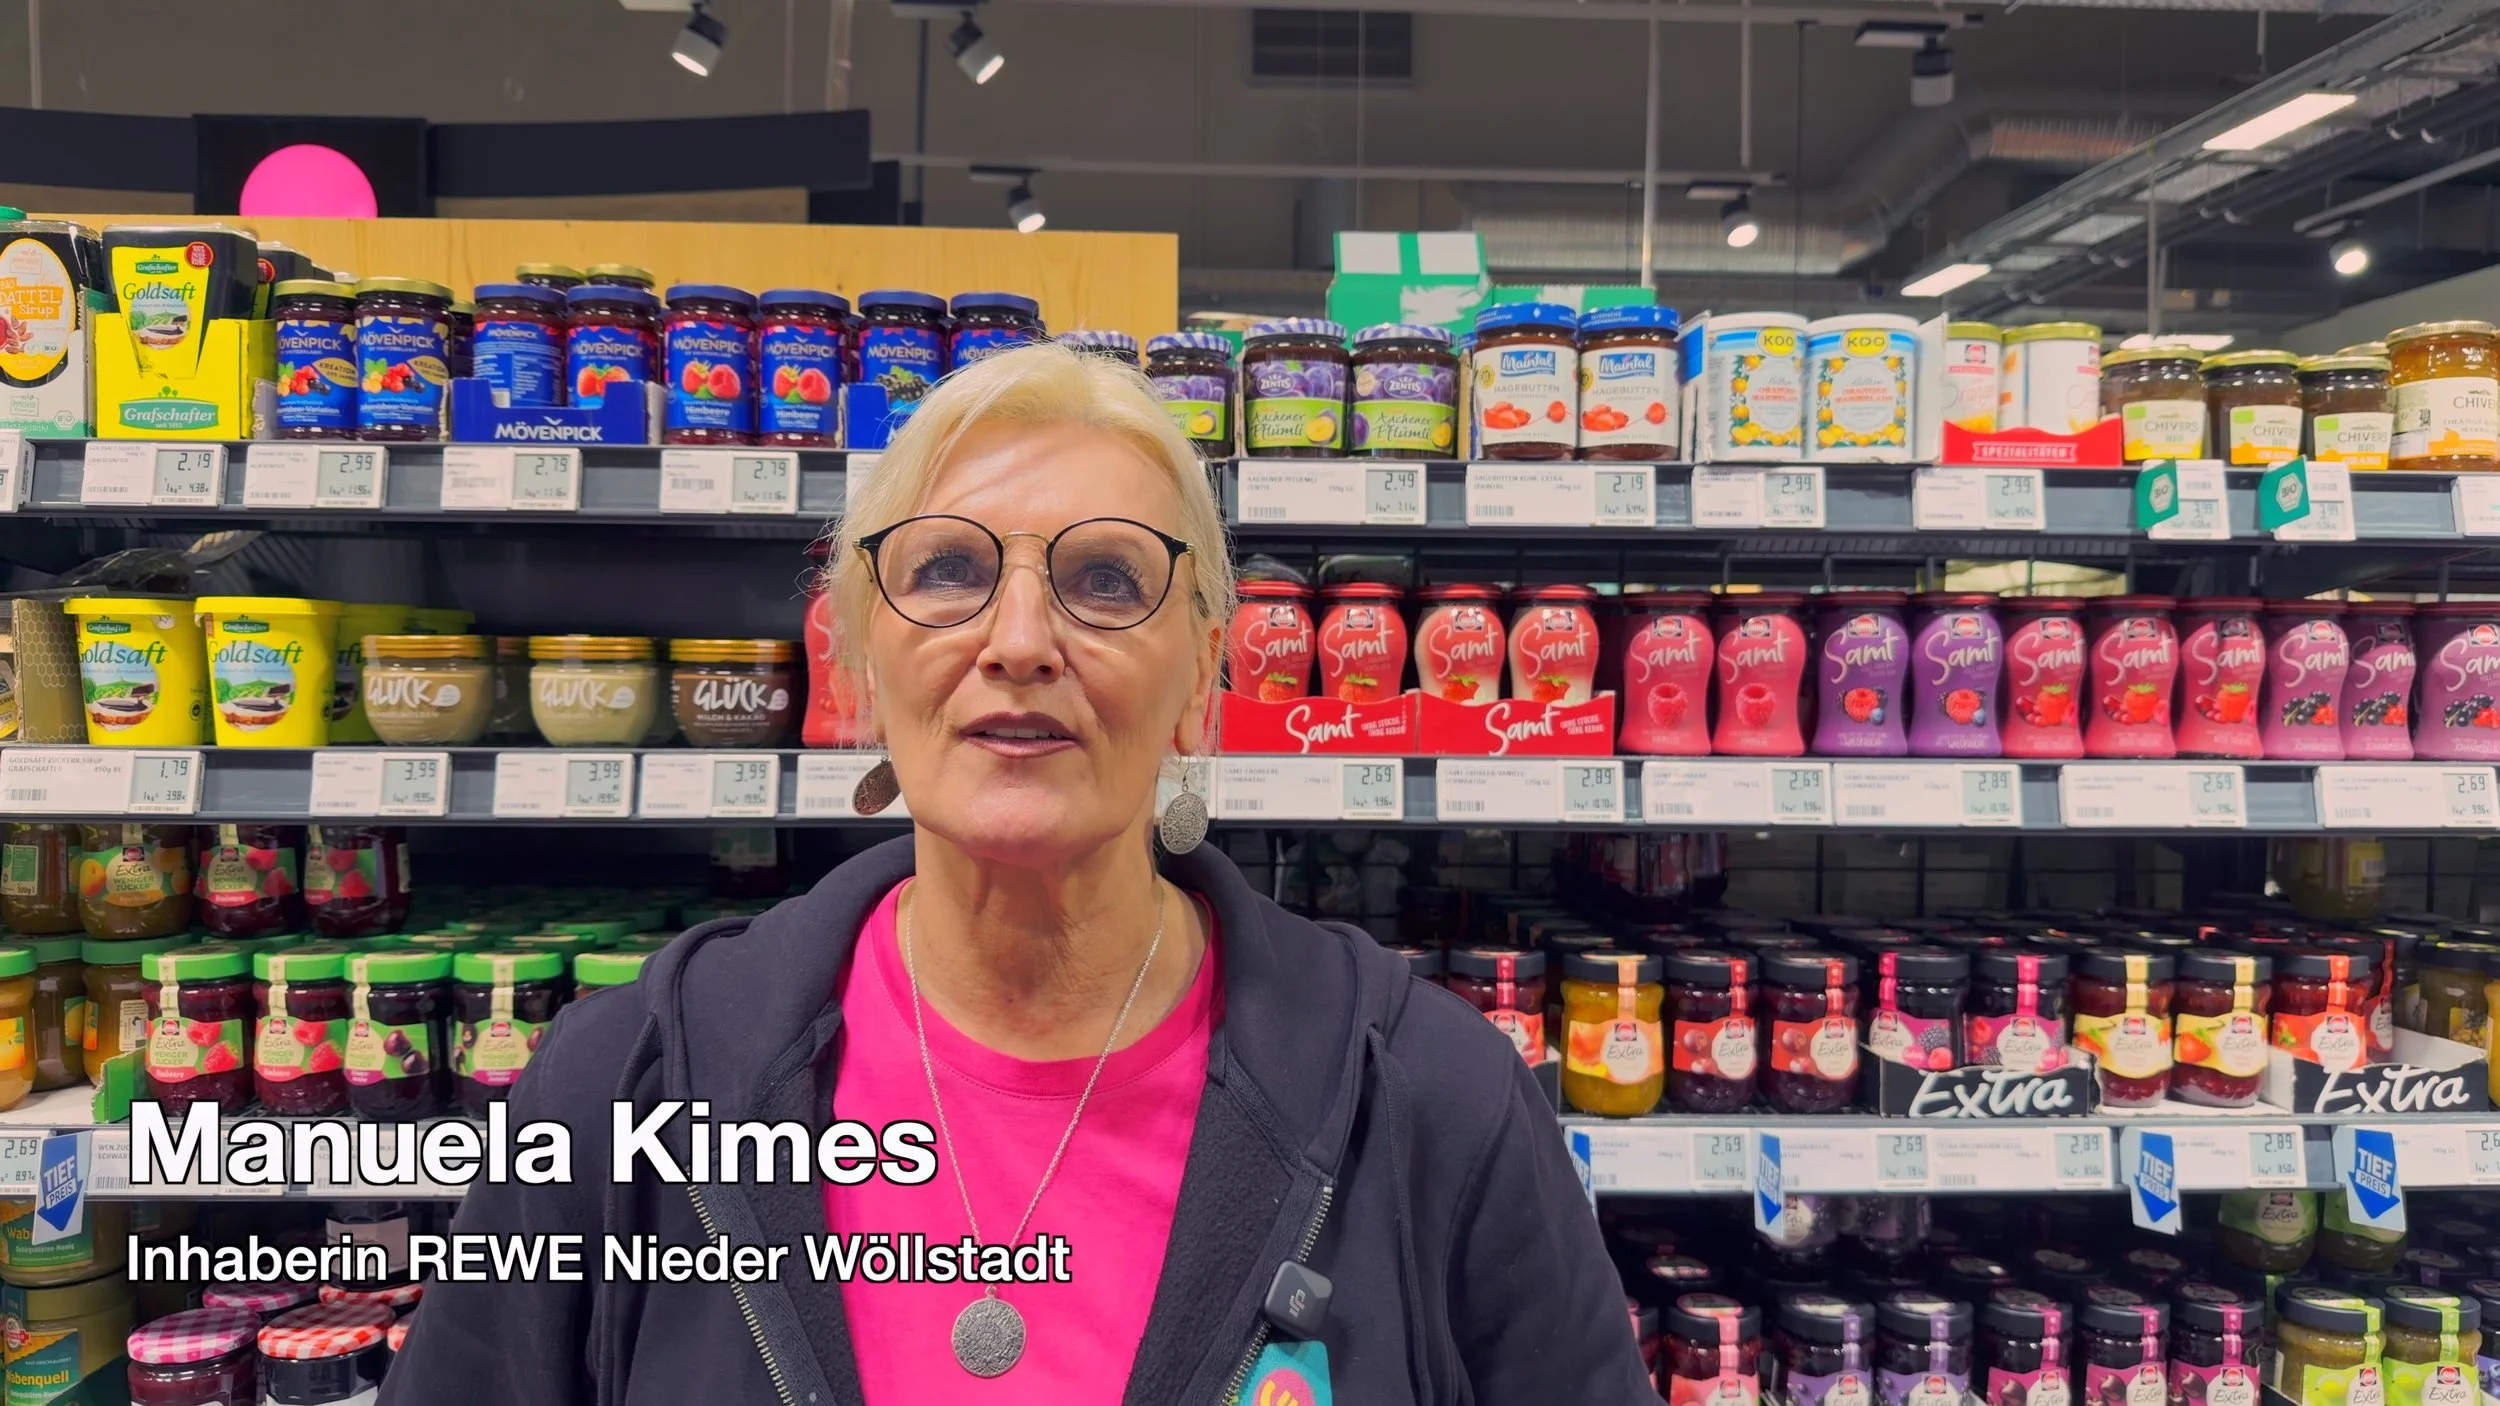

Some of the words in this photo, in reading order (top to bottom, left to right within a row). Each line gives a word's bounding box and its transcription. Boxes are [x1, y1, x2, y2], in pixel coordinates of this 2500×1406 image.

[123, 282, 197, 302] Goldsaft
[19, 305, 54, 321] Sirup
[360, 331, 435, 349] MÖVENPICK
[487, 325, 538, 340] MÖVENPICK
[1763, 335, 1794, 346] KOO
[278, 335, 341, 350] ÖVENPICK
[573, 339, 643, 358] MÖVENPICK
[673, 336, 746, 354] MÖVENPICK
[765, 340, 836, 358] MÖVENPICK
[1848, 337, 1885, 347] KOO
[868, 342, 939, 362] MÖVENPICK
[1501, 352, 1554, 370] Maintal
[1600, 354, 1652, 373] Maintal
[1261, 377, 1292, 391] ZENTIS
[1388, 379, 1422, 392] ZENTIS
[1494, 383, 1560, 394] HAGEBUTTEN
[1592, 386, 1660, 396] HAGEBUTTEN
[685, 406, 731, 417] Himbeere
[2453, 396, 2494, 410] CHIVE
[124, 406, 216, 423] Grafschafter
[776, 409, 820, 421] Himbeere
[1252, 408, 1306, 423] Aachener
[1376, 412, 1433, 426] Aachener
[494, 421, 603, 441] MÖVENPICK
[1251, 423, 1304, 441] Pflümli
[1376, 425, 1431, 443] Pflümli
[2144, 420, 2199, 431] CHIVERS
[2337, 431, 2387, 443] CHIVERS
[177, 452, 211, 472] 2.19
[340, 455, 373, 473] 2.99
[535, 457, 568, 476] 2.79
[753, 461, 787, 480] 2.79
[1384, 473, 1415, 491] 2.49
[1613, 476, 1643, 493] 2.19
[1781, 475, 1812, 495] 2.99
[2001, 477, 2031, 496] 2.99
[2154, 485, 2169, 499] BIO
[2281, 484, 2298, 499] BIO
[208, 640, 304, 666] Goldsaft
[1244, 619, 1312, 676] Samt
[1323, 618, 1396, 678] Samt
[1429, 618, 1501, 679] Samt
[1520, 618, 1592, 679] Samt
[1630, 627, 1702, 683] Samt
[1718, 627, 1790, 685] Samt
[1825, 627, 1900, 684] Samt
[2014, 627, 2084, 685] Samt
[1925, 628, 2000, 686] Samt
[2100, 629, 2173, 687] Samt
[2192, 629, 2264, 687] Samt
[2280, 629, 2348, 689] Samt
[693, 676, 768, 711] GLÜCK
[1286, 703, 1362, 754] Samt
[1486, 702, 1561, 757] Samt
[160, 760, 188, 778] 1.79
[405, 761, 438, 781] 3.99
[588, 762, 621, 782] 3.99
[734, 763, 768, 782] 3.99
[1361, 767, 1392, 786] 2.69
[1582, 768, 1612, 788] 2.89
[1790, 771, 1820, 790] 2.69
[1978, 773, 2008, 791] 2.89
[2203, 774, 2232, 793] 2.69
[2457, 776, 2486, 794] 2.69
[116, 862, 151, 876] Extra
[215, 863, 245, 876] Extra
[113, 876, 154, 885] WENIGER
[213, 876, 248, 885] WENIGER
[155, 1035, 187, 1050] Extra
[263, 1035, 292, 1049] Extra
[350, 1039, 375, 1051] Extra
[1872, 1033, 1904, 1048] Extra
[2003, 1039, 2044, 1057] Extra
[2114, 1038, 2152, 1053] Extra
[2224, 1036, 2257, 1051] Extra
[2318, 1036, 2356, 1053] Extra
[153, 1050, 188, 1059] WENIGER
[262, 1050, 294, 1059] WENIGER
[1607, 1044, 1644, 1061] Extra
[1718, 1043, 1750, 1058] Extra
[1818, 1043, 1850, 1058] Extra
[1909, 1070, 2073, 1118] Extra
[2314, 1066, 2470, 1114] Extra
[4, 1139, 38, 1159] 2.69
[1712, 1136, 1742, 1155] 2.69
[1892, 1135, 1923, 1155] 2.69
[2070, 1134, 2100, 1155] 2.89
[2264, 1133, 2293, 1153] 2.89
[2481, 1132, 2500, 1151] 2.6
[2142, 1151, 2173, 1185] TIEF
[2358, 1147, 2392, 1180] TIEF
[44, 1155, 77, 1192] TIEF
[2142, 1176, 2167, 1200] PREIS
[2360, 1172, 2388, 1196] PREIS
[49, 1181, 74, 1206] PREIS
[2262, 1209, 2299, 1224] Extra
[2134, 1388, 2164, 1403] Extra
[2213, 1388, 2250, 1403] Extra
[2428, 1387, 2468, 1404] Extra
